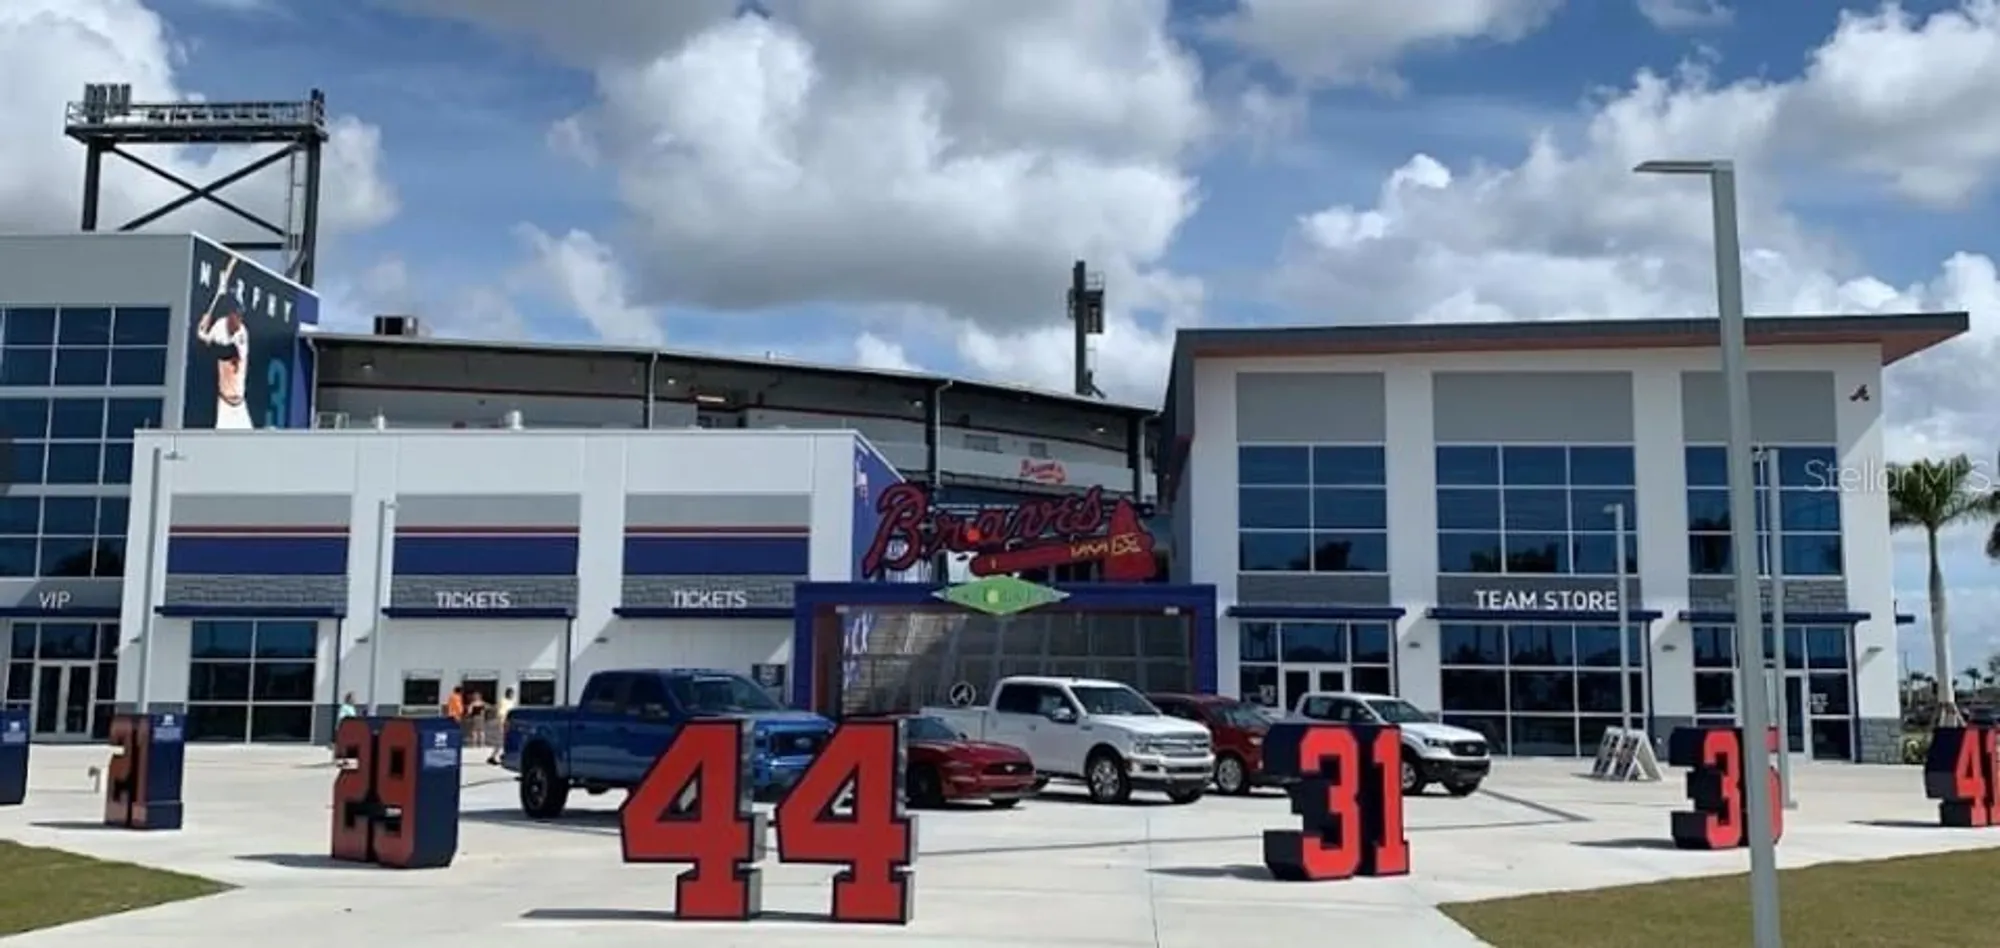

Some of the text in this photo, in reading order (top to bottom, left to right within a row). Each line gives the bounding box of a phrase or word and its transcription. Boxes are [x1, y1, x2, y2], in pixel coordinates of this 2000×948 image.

[862, 482, 1105, 579] Braves
[39, 591, 71, 609] VIP
[434, 590, 511, 609] TICKETS
[671, 590, 748, 609] TICKETS
[1473, 589, 1619, 611] TEAM STORE
[104, 713, 150, 829] 21
[332, 717, 421, 868] 29
[1295, 724, 1410, 882] 31
[618, 717, 916, 925] 44
